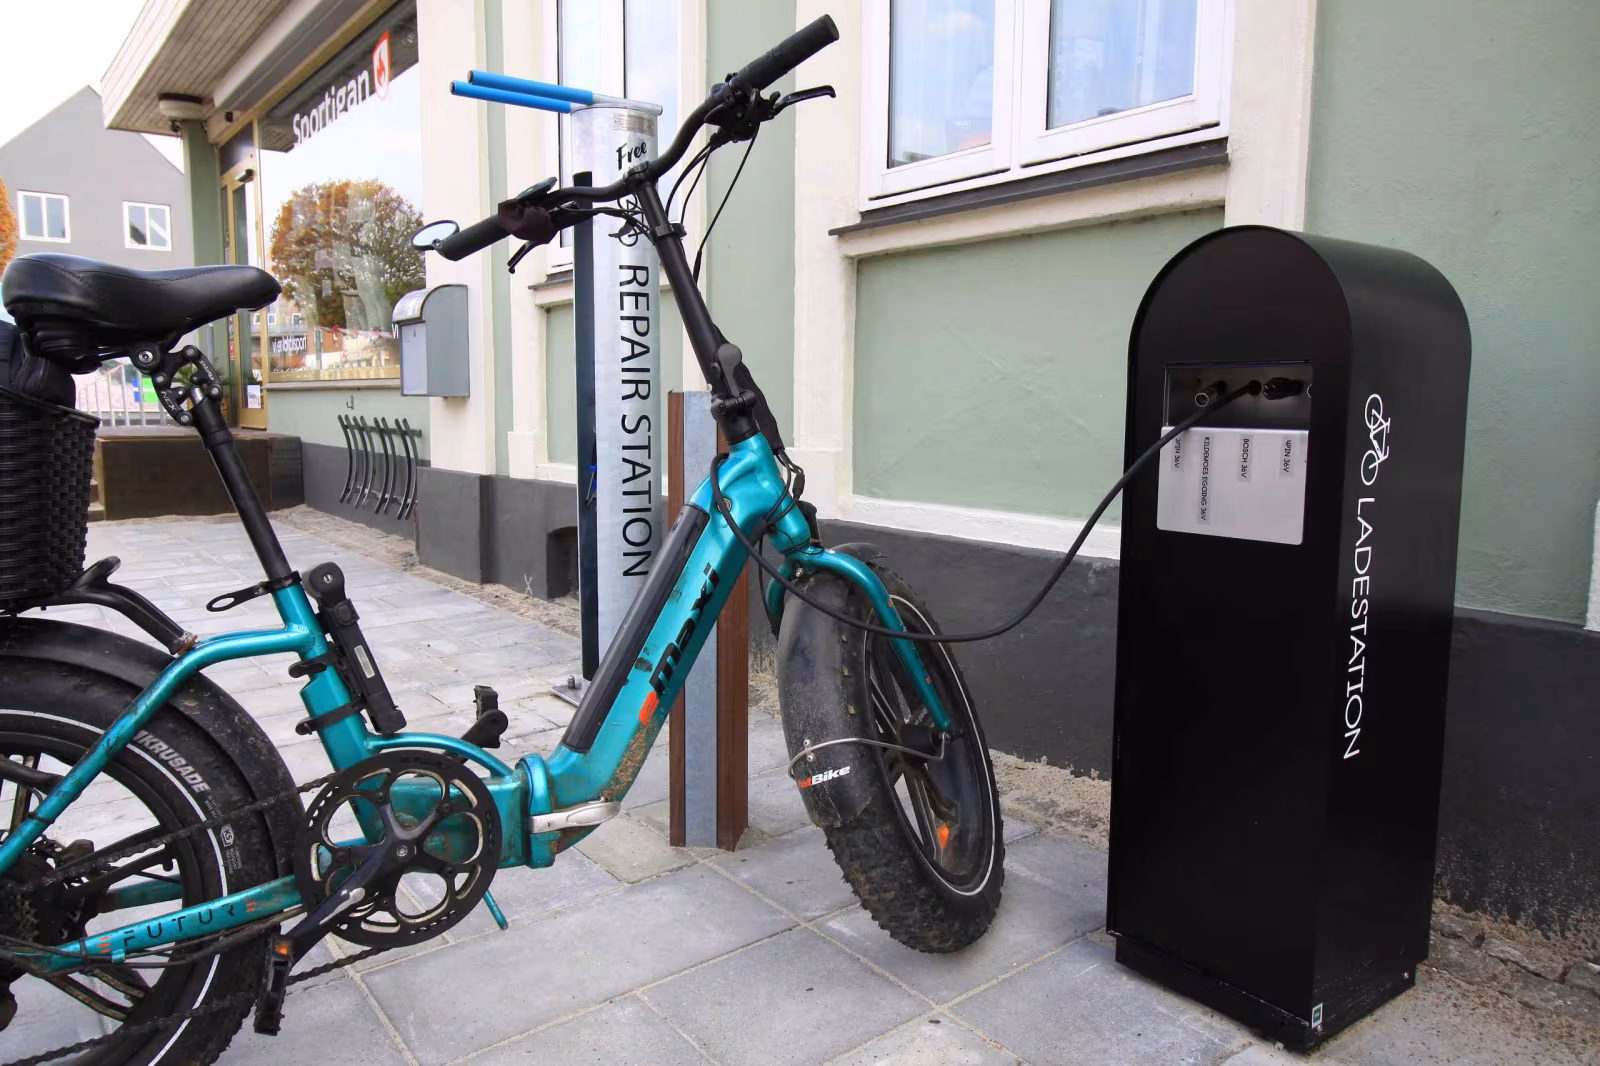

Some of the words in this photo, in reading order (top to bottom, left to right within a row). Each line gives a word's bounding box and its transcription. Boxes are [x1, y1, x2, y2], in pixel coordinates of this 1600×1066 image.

[292, 69, 370, 146] Sportigan
[616, 142, 647, 170] Free
[618, 264, 651, 401] REPAIR
[1202, 436, 1210, 476] KILDEMOES
[1242, 438, 1250, 464] BOSCH
[1284, 439, 1292, 458] 4PIN
[620, 413, 652, 577] STATION
[1201, 476, 1209, 506] EGOING
[1343, 497, 1375, 760] LADESTATION
[137, 733, 212, 794] KRUSADE
